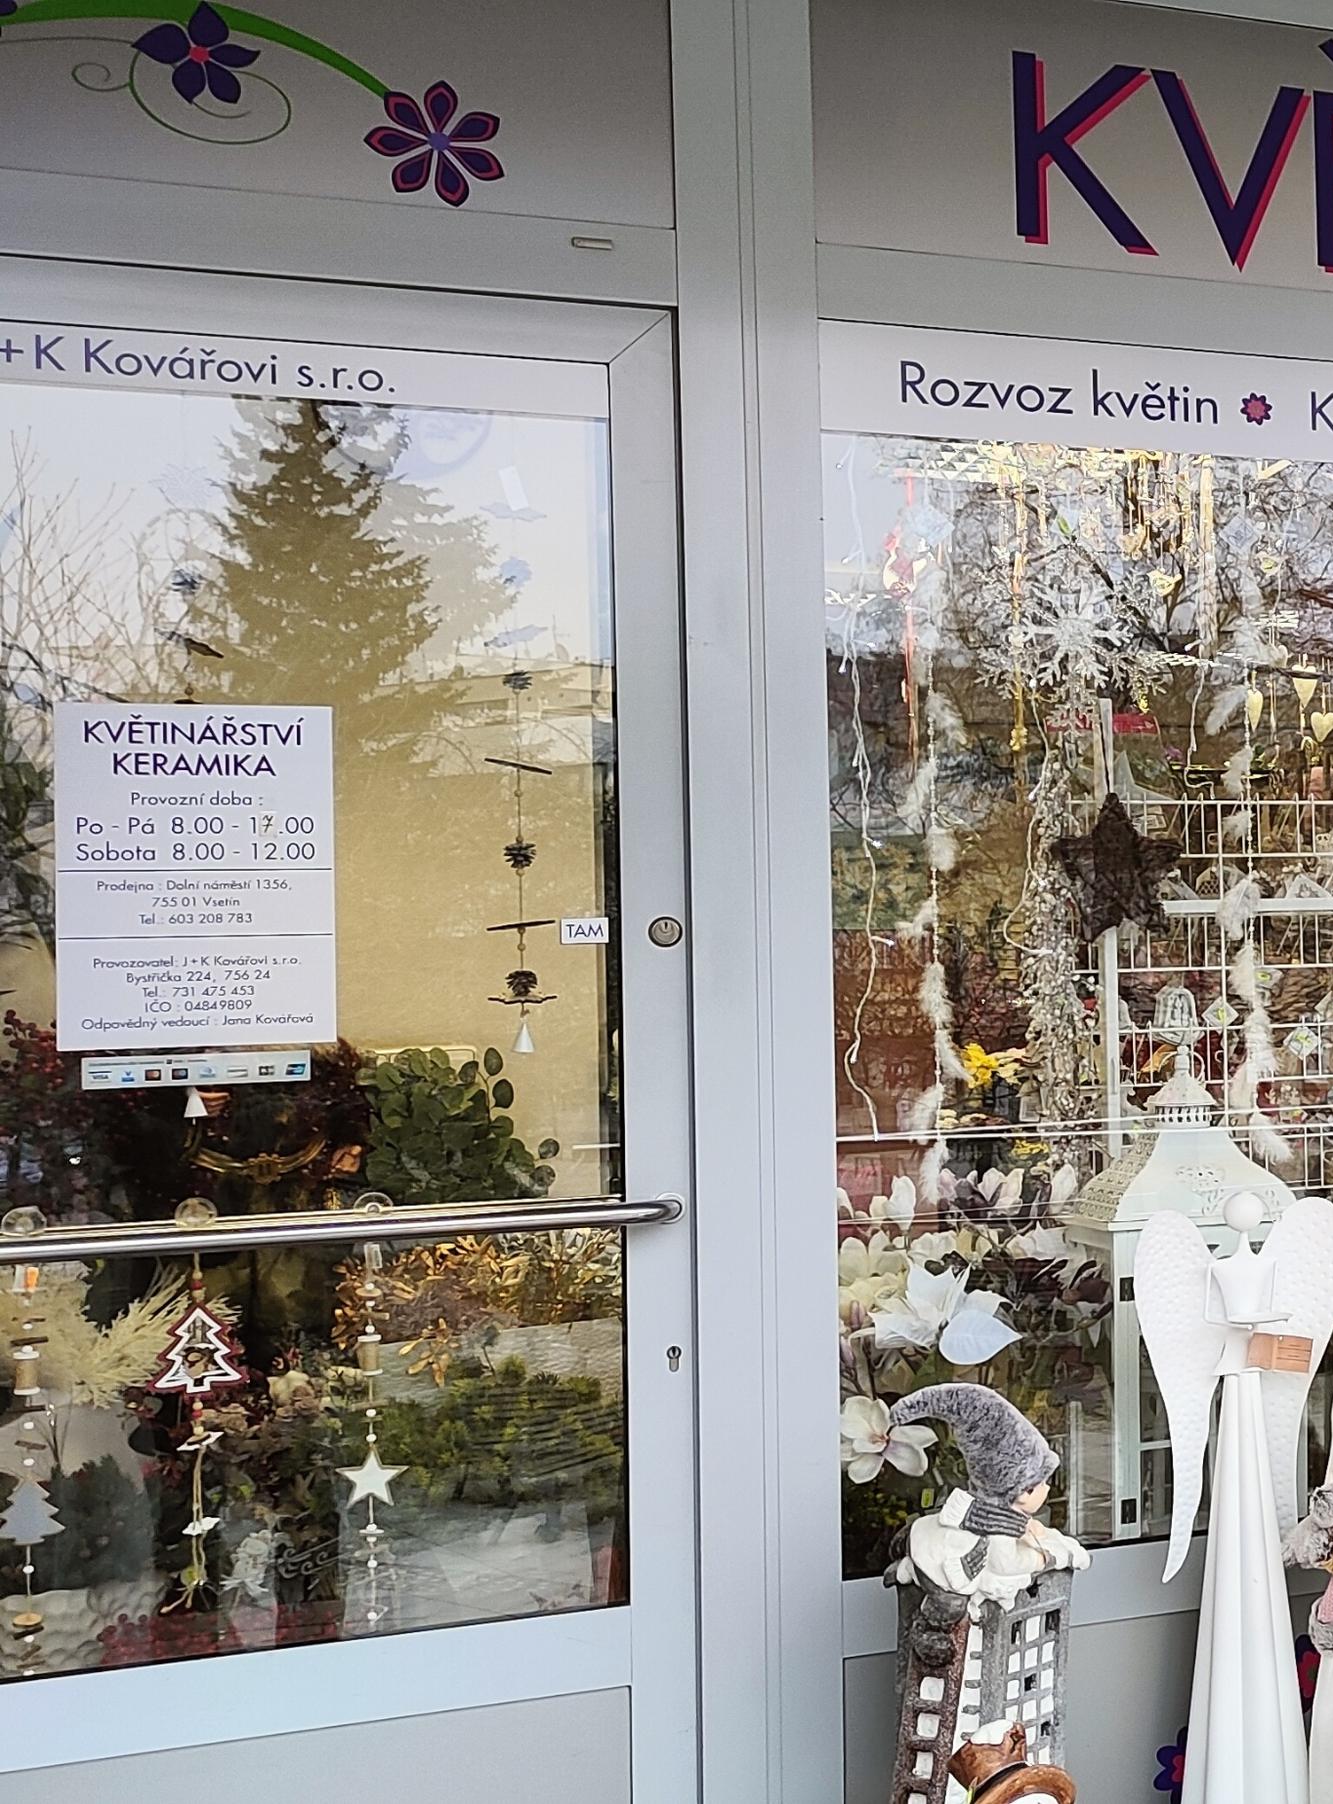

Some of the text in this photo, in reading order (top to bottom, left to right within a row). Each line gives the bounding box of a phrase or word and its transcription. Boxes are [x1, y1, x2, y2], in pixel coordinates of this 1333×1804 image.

[84, 337, 278, 385] Kovářovi
[297, 363, 396, 393] s.r.o.
[900, 360, 1219, 425] Rozvoz květin
[83, 713, 305, 746] KVĚTINÁŘSTVÍ
[112, 752, 277, 777] KERAMIKA
[131, 791, 205, 806] Provozní
[209, 790, 253, 806] doba
[76, 817, 104, 835] Po
[128, 817, 155, 835] Pá
[171, 817, 224, 835] 8.00
[250, 814, 315, 836] 17.00
[76, 841, 157, 862] Sobota
[172, 843, 225, 861] 8.00
[251, 843, 315, 861] 12.00
[97, 880, 154, 894] Prodejna
[166, 879, 200, 891] Dolní
[203, 879, 251, 891] náměstí
[151, 896, 241, 908] 755 01 Vsetín
[168, 914, 194, 924] 603
[199, 914, 224, 924] 208
[227, 913, 253, 924] 783
[566, 924, 604, 938] TAM
[126, 971, 182, 985] Bystřička
[224, 970, 250, 981] 756
[254, 969, 271, 980] 24
[172, 986, 195, 997] 731
[201, 985, 226, 997] 475
[231, 985, 255, 996] 453
[145, 999, 172, 1013] IČO
[184, 999, 253, 1012] 04849809
[81, 1016, 158, 1032] Odpovědný
[162, 1015, 211, 1027] vedoucí
[221, 1015, 251, 1027] Jana
